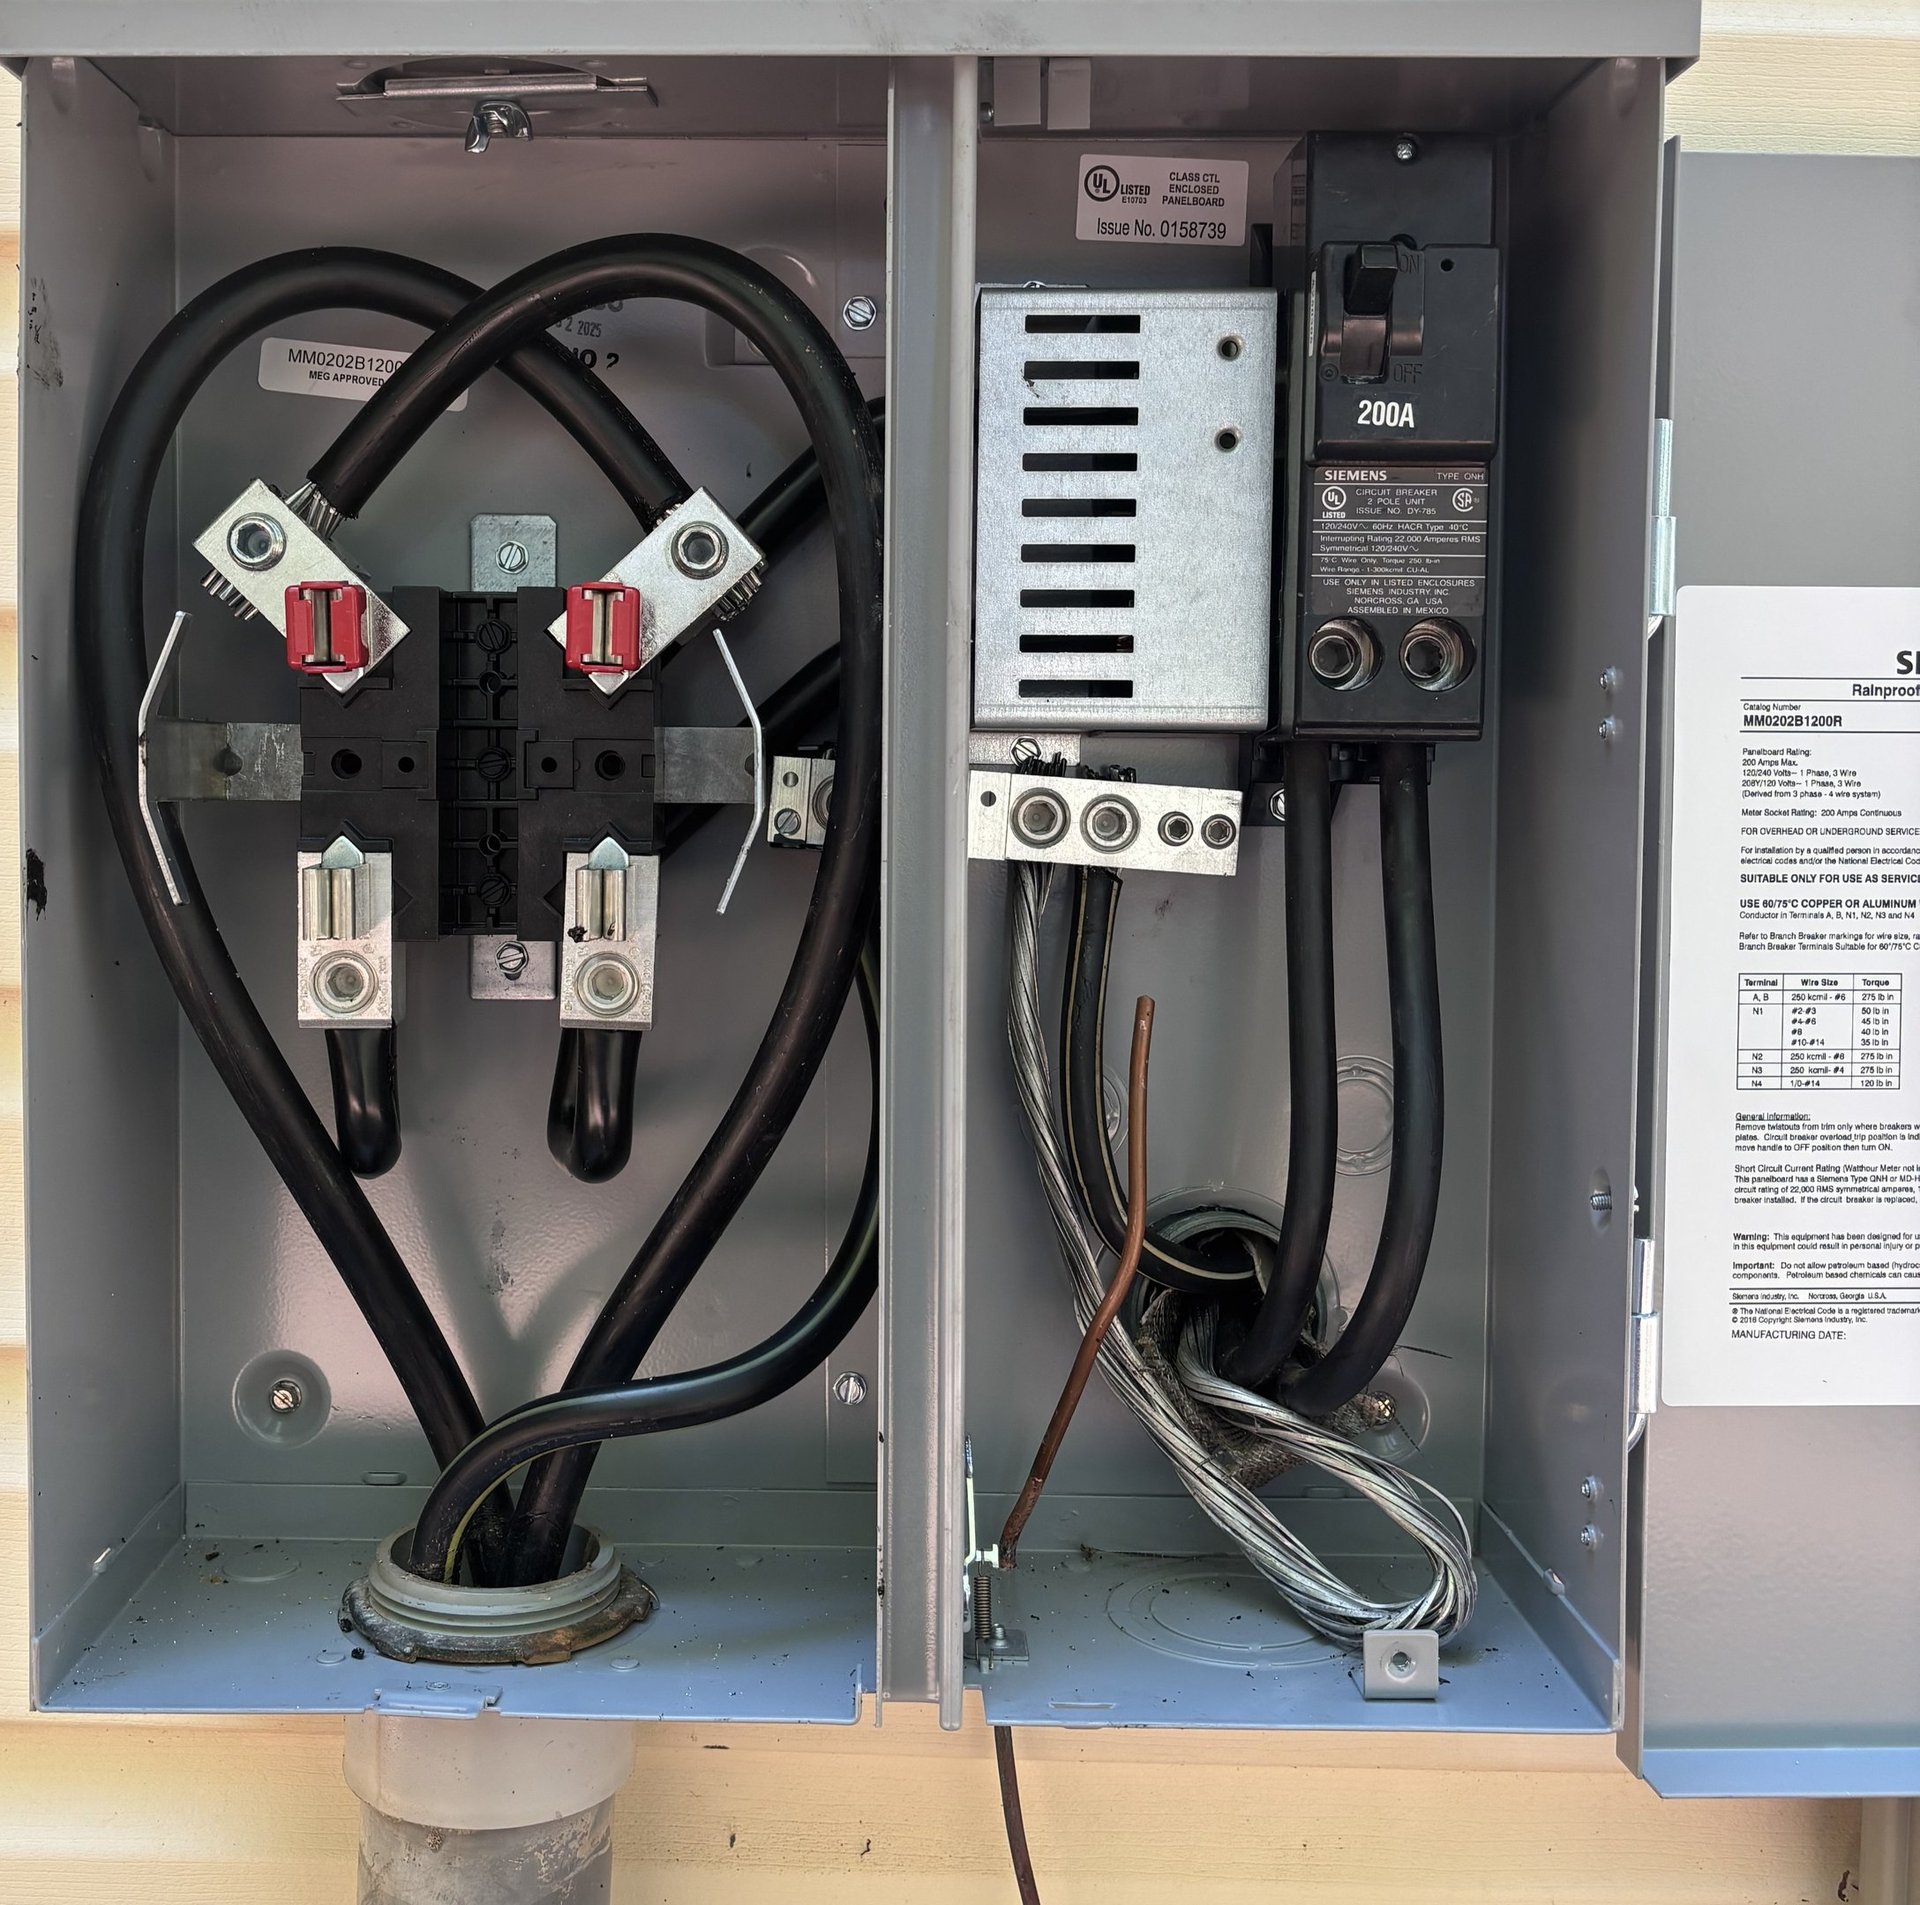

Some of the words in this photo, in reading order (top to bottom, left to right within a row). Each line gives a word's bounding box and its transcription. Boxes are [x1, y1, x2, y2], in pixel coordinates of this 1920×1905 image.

[1169, 172, 1200, 182] CLASS
[1202, 173, 1220, 183] CTL
[1121, 184, 1150, 196] LISTED
[1169, 184, 1219, 194] ENCLOSED
[1122, 196, 1147, 204] E10703
[1162, 196, 1225, 207] PANELBOARD
[1097, 218, 1129, 235] Issue
[1134, 219, 1155, 237] No.
[1160, 220, 1226, 239] 0158739
[1400, 255, 1419, 273] ON
[577, 320, 602, 337] 2025
[1394, 364, 1422, 383] OFF
[309, 371, 330, 380] MEG
[332, 373, 385, 386] APPROVED
[1357, 400, 1414, 428] 200A
[1325, 470, 1387, 481] SIEMENS
[1425, 524, 1443, 532] Type
[1320, 535, 1364, 543] Interrupting
[1367, 535, 1392, 543] Rating
[1423, 536, 1458, 544] Amperes
[1744, 703, 1770, 712] Catalog
[1744, 715, 1842, 727] MM0202B1200R
[1786, 748, 1812, 757] Rating:
[1758, 759, 1779, 767] Amps
[1743, 769, 1771, 777] 120/240
[1806, 769, 1831, 778] Phase,
[1742, 790, 1772, 798] (Derived
[1774, 790, 1791, 798] from
[1800, 791, 1822, 799] phase
[1852, 791, 1881, 799] system)
[1791, 809, 1817, 818] Rating:
[1837, 809, 1858, 818] Amps
[1860, 809, 1902, 817] Continuous
[1740, 874, 1788, 883] SUITABLE
[1791, 874, 1816, 883] ONLY
[1819, 874, 1840, 883] FOR
[1842, 874, 1862, 883] USE
[1865, 874, 1878, 883] AS
[1740, 899, 1759, 908] USE
[1801, 899, 1842, 908] COPPER
[1845, 900, 1859, 908] OR
[1862, 900, 1916, 908] ALUMINUM
[1826, 912, 1833, 920] A,
[1836, 912, 1843, 920] B,
[1846, 912, 1858, 920] N1,
[1861, 912, 1873, 920] N2,
[1862, 979, 1889, 987] Torque
[1753, 994, 1760, 1002] A,
[1733, 1233, 1769, 1242] Warning:
[1733, 1262, 1774, 1271] Important:
[1732, 1330, 1815, 1339] MANUFACTURING
[1818, 1330, 1846, 1340] DATE:
